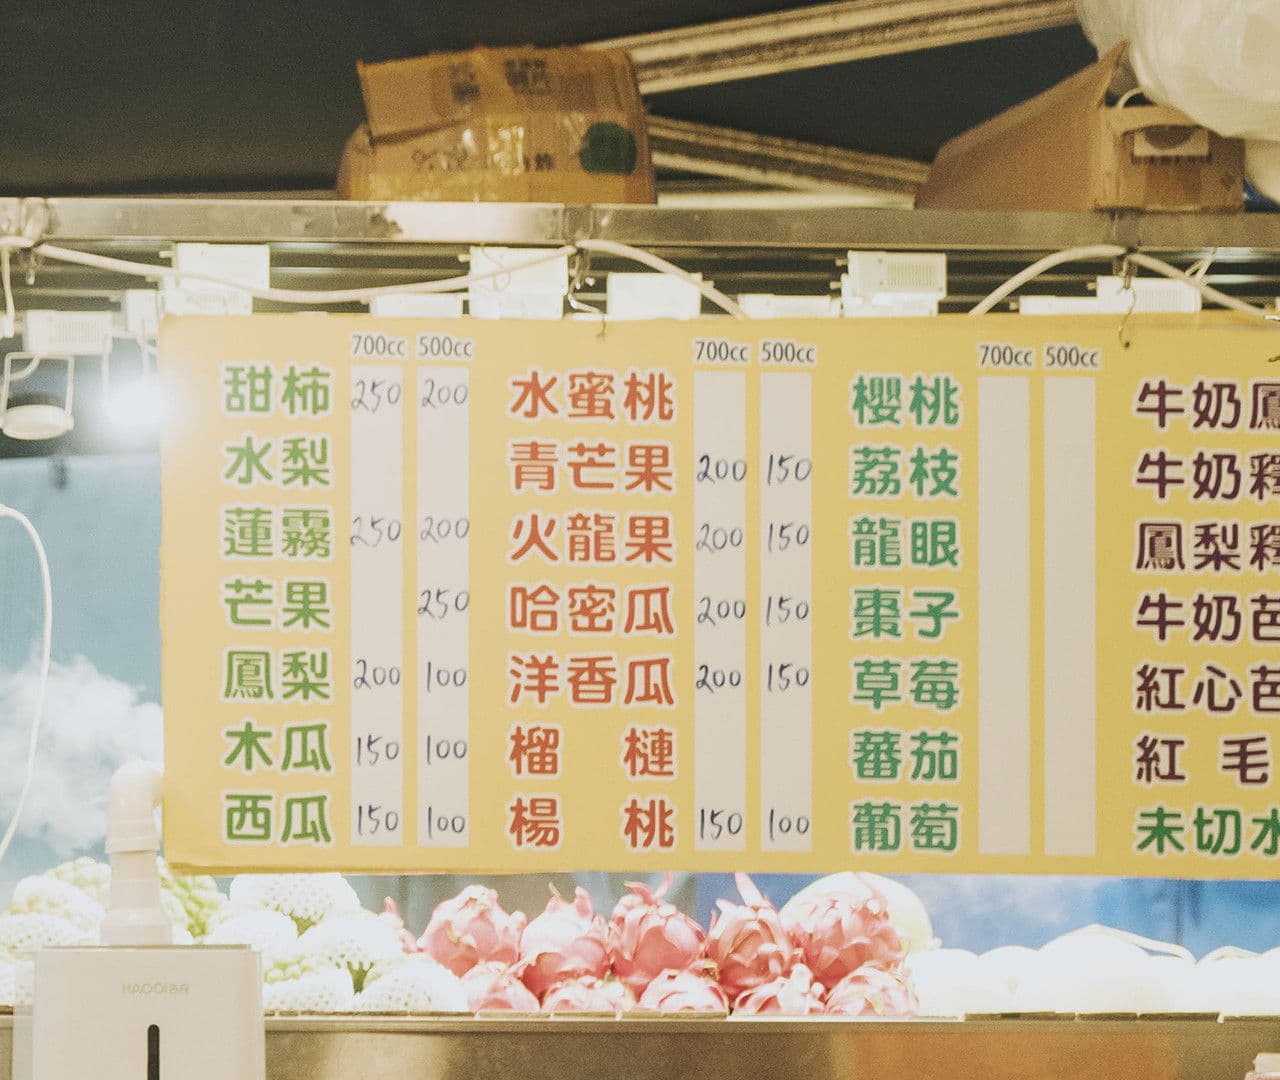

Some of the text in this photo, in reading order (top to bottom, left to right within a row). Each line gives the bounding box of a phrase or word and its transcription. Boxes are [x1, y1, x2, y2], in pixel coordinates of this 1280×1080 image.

[353, 335, 473, 358] 700cc 500cc
[696, 341, 815, 363] 700cc 500cc
[979, 345, 1098, 368] 700cc 500cc
[224, 365, 330, 416] 甜柿
[351, 379, 468, 411] 250 200
[511, 371, 672, 419] 水蜜桃
[852, 376, 959, 426] 櫻桃
[224, 437, 330, 486] 水梨
[510, 441, 672, 491] 青芒果
[697, 454, 813, 485] 200 150
[852, 447, 959, 497] 荔枝
[224, 508, 330, 558] 蓮霧
[350, 517, 470, 548] 250 200
[510, 513, 671, 561] 火龍果
[696, 523, 809, 553] 200 150
[852, 518, 959, 568] 龍眼
[224, 580, 330, 629] 芒果
[416, 588, 471, 618] 250
[511, 585, 672, 633] 哈密瓜
[698, 596, 809, 626] 200 150
[852, 589, 959, 639] 棗子
[224, 651, 330, 700] 鳳梨
[354, 659, 466, 689] 200 100
[510, 656, 673, 704] 洋香瓜
[696, 663, 809, 692] 200 150
[852, 660, 959, 710] 草莓
[224, 723, 330, 772] 木瓜
[357, 735, 467, 765] 150 100
[852, 731, 959, 782] 蕃茄
[224, 795, 330, 844] 西瓜
[358, 805, 465, 838] 150 100
[700, 808, 809, 840] 150 100
[852, 803, 959, 852] 葡萄
